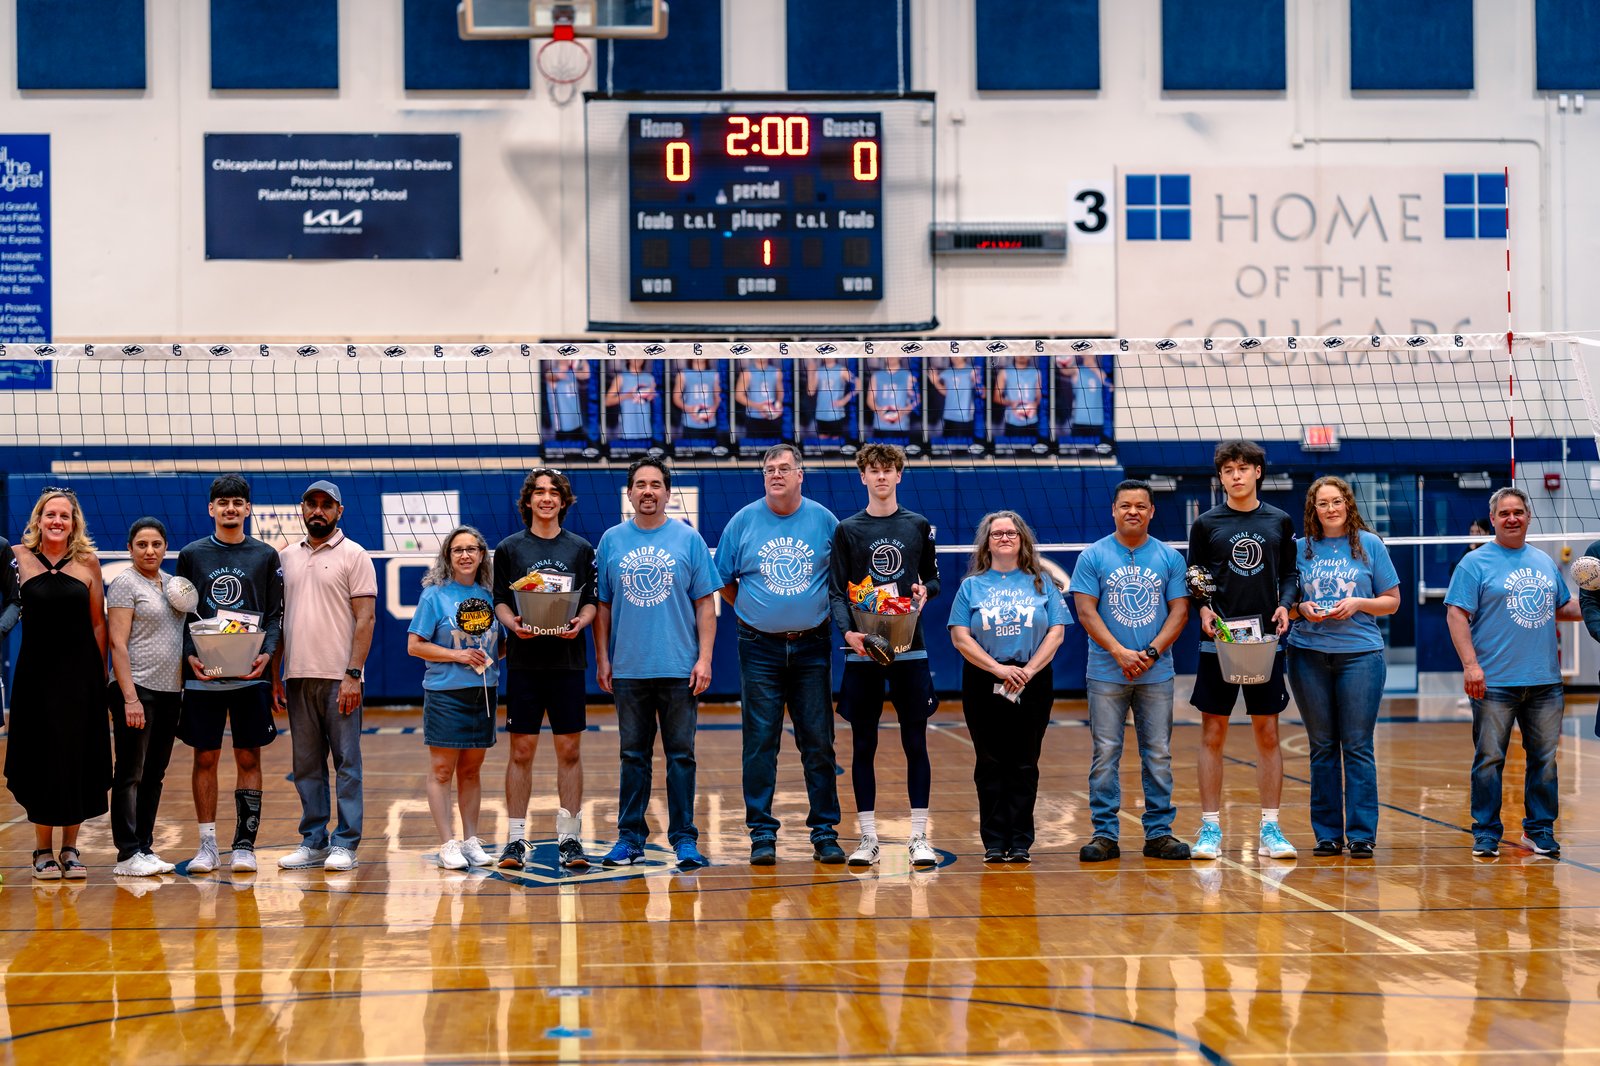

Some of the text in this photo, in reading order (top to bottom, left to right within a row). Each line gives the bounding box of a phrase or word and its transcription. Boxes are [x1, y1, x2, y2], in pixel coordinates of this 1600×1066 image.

[640, 119, 683, 138] Home
[727, 116, 809, 156] 2:00
[822, 118, 876, 138] Guests
[5, 158, 31, 175] the
[212, 159, 453, 172] Chicagoland and Northwest Indiana Kia Dealers
[665, 142, 690, 182] 0
[853, 141, 878, 181] 0
[291, 176, 375, 189] Proud to support
[732, 181, 780, 200] period
[258, 189, 408, 203] Plainfield South High School
[303, 209, 363, 226] KIA
[1074, 188, 1109, 234] 3
[1215, 193, 1422, 245] HOME
[637, 211, 674, 230] fouls
[731, 210, 782, 231] player
[838, 210, 875, 230] fouls
[763, 239, 771, 265] 1
[641, 278, 672, 293] won
[737, 277, 776, 296] game
[842, 276, 873, 292] won
[1236, 265, 1394, 298] OF THE
[869, 538, 905, 551] FINAL SET
[1229, 532, 1266, 544] FINAL SET
[758, 537, 815, 558] SENIOR DAD
[554, 561, 568, 571] SET
[619, 546, 676, 569] SENIOR DAD
[1310, 554, 1350, 569] Senior
[209, 566, 246, 579] FINAL SET
[760, 564, 813, 574] 20 25
[1106, 566, 1162, 587] SENIOR DAD
[1301, 567, 1360, 583] Volleyball
[662, 573, 673, 584] 25
[1503, 568, 1554, 590] SENIOR DAD
[764, 579, 811, 596] FINISH STRONG
[988, 586, 1025, 599] Senior
[623, 589, 671, 607] FINISH STRONG
[979, 596, 1035, 609] Volleyball
[1108, 594, 1160, 604] 20 25
[1506, 598, 1518, 608] 20
[1111, 610, 1132, 628] FINISH
[1510, 612, 1533, 629] FINISH
[995, 624, 1021, 637] 2025
[894, 644, 911, 654] Alex
[1230, 674, 1265, 684] #7 Emilio
